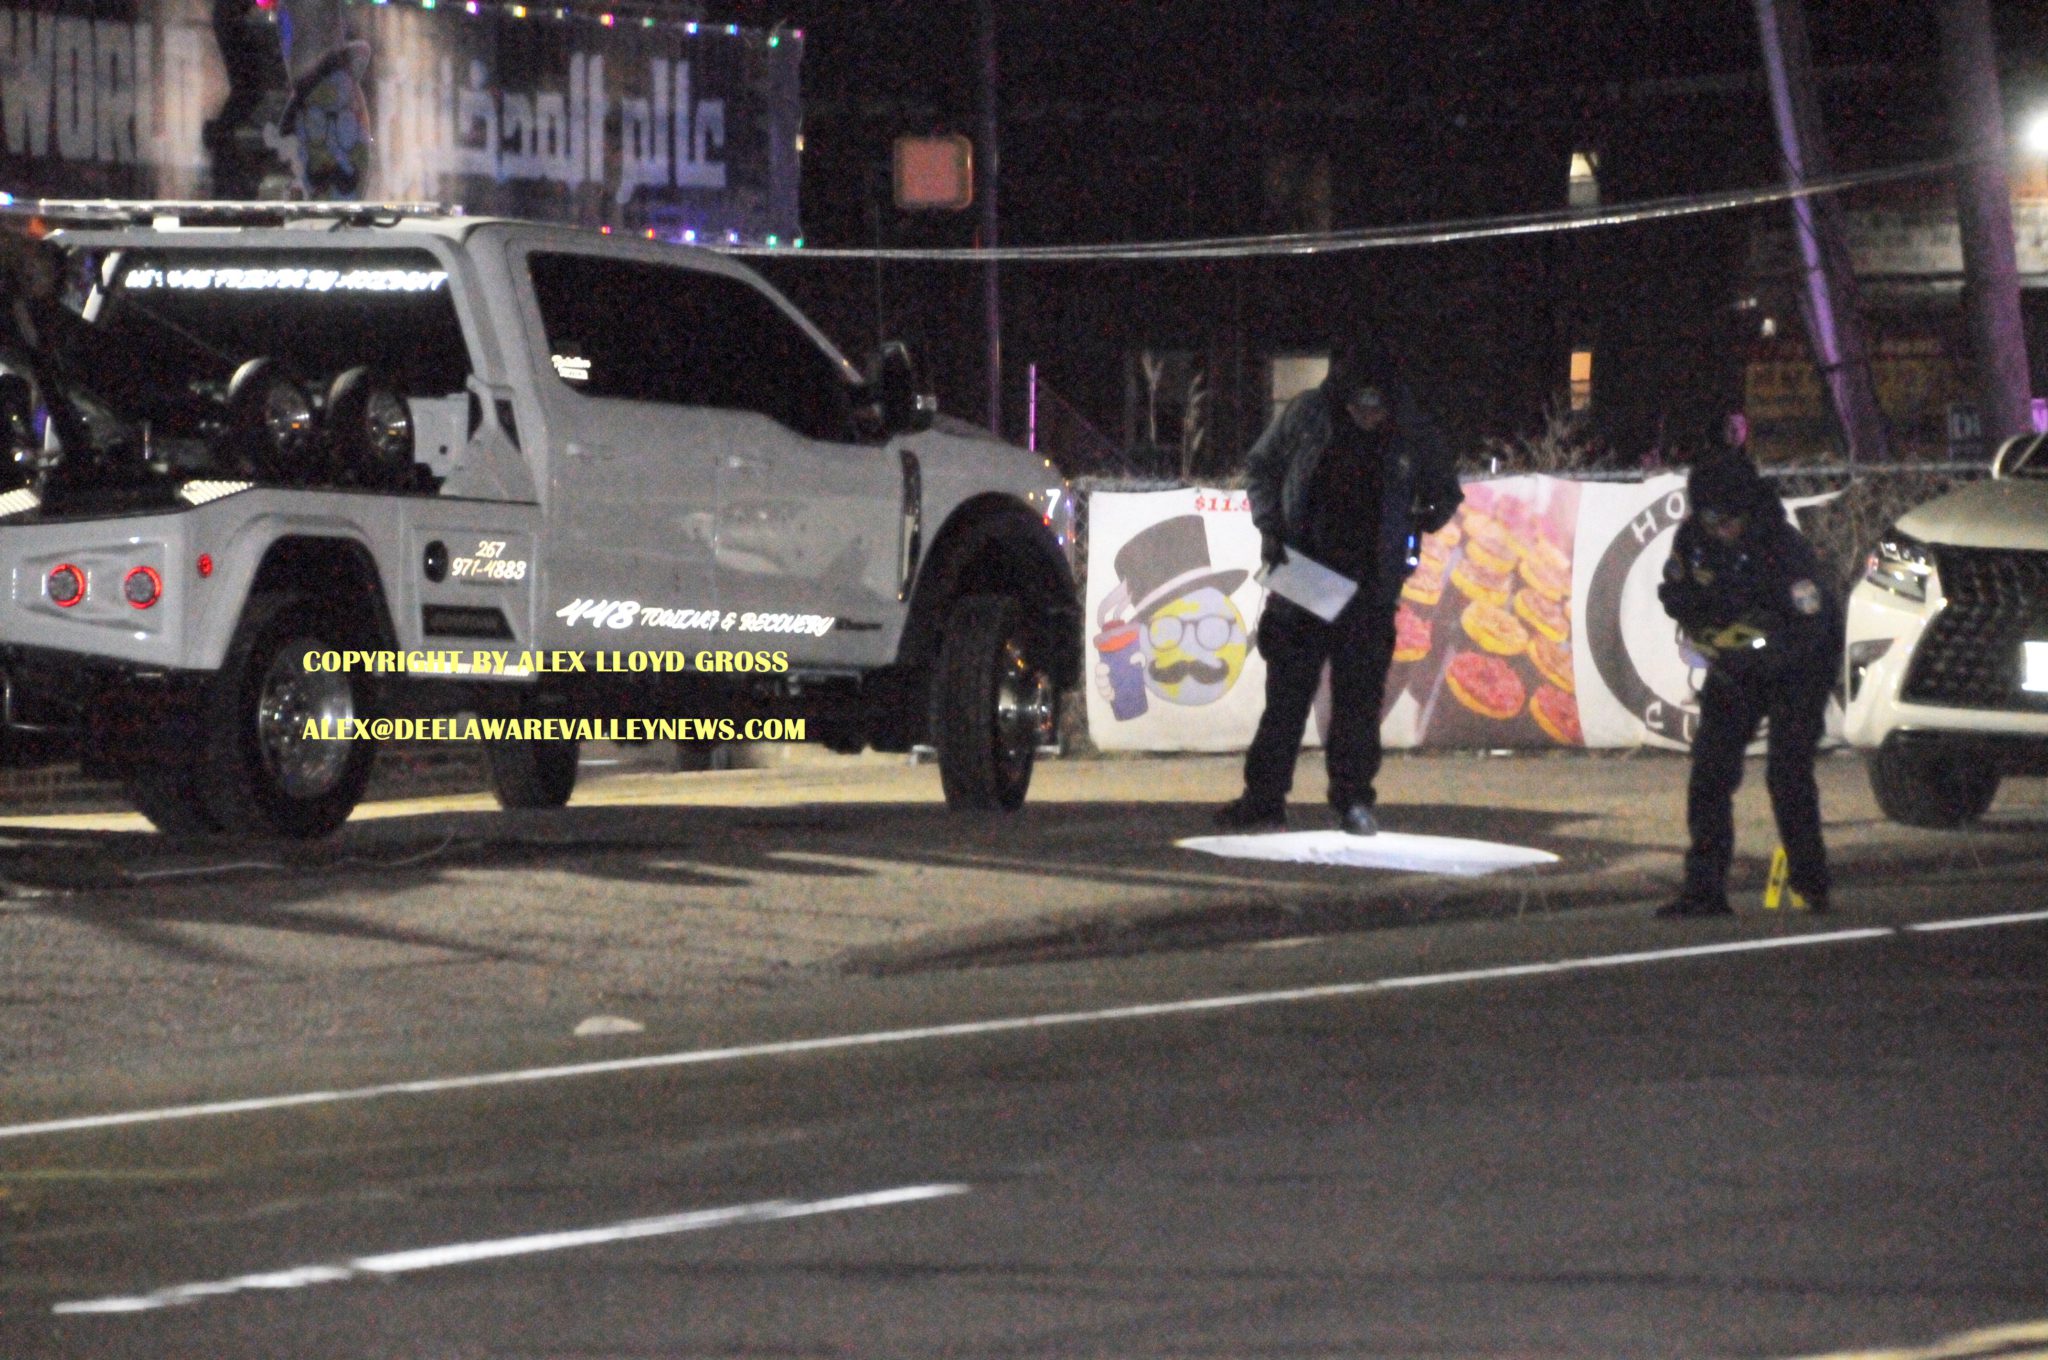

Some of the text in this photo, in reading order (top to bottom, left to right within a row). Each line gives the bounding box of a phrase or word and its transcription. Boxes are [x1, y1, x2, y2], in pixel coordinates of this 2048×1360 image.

[0, 10, 203, 168] WORLD
[475, 541, 506, 558] 267
[555, 598, 641, 629] 448
[720, 611, 737, 632] &
[738, 611, 835, 637] RECOVERY
